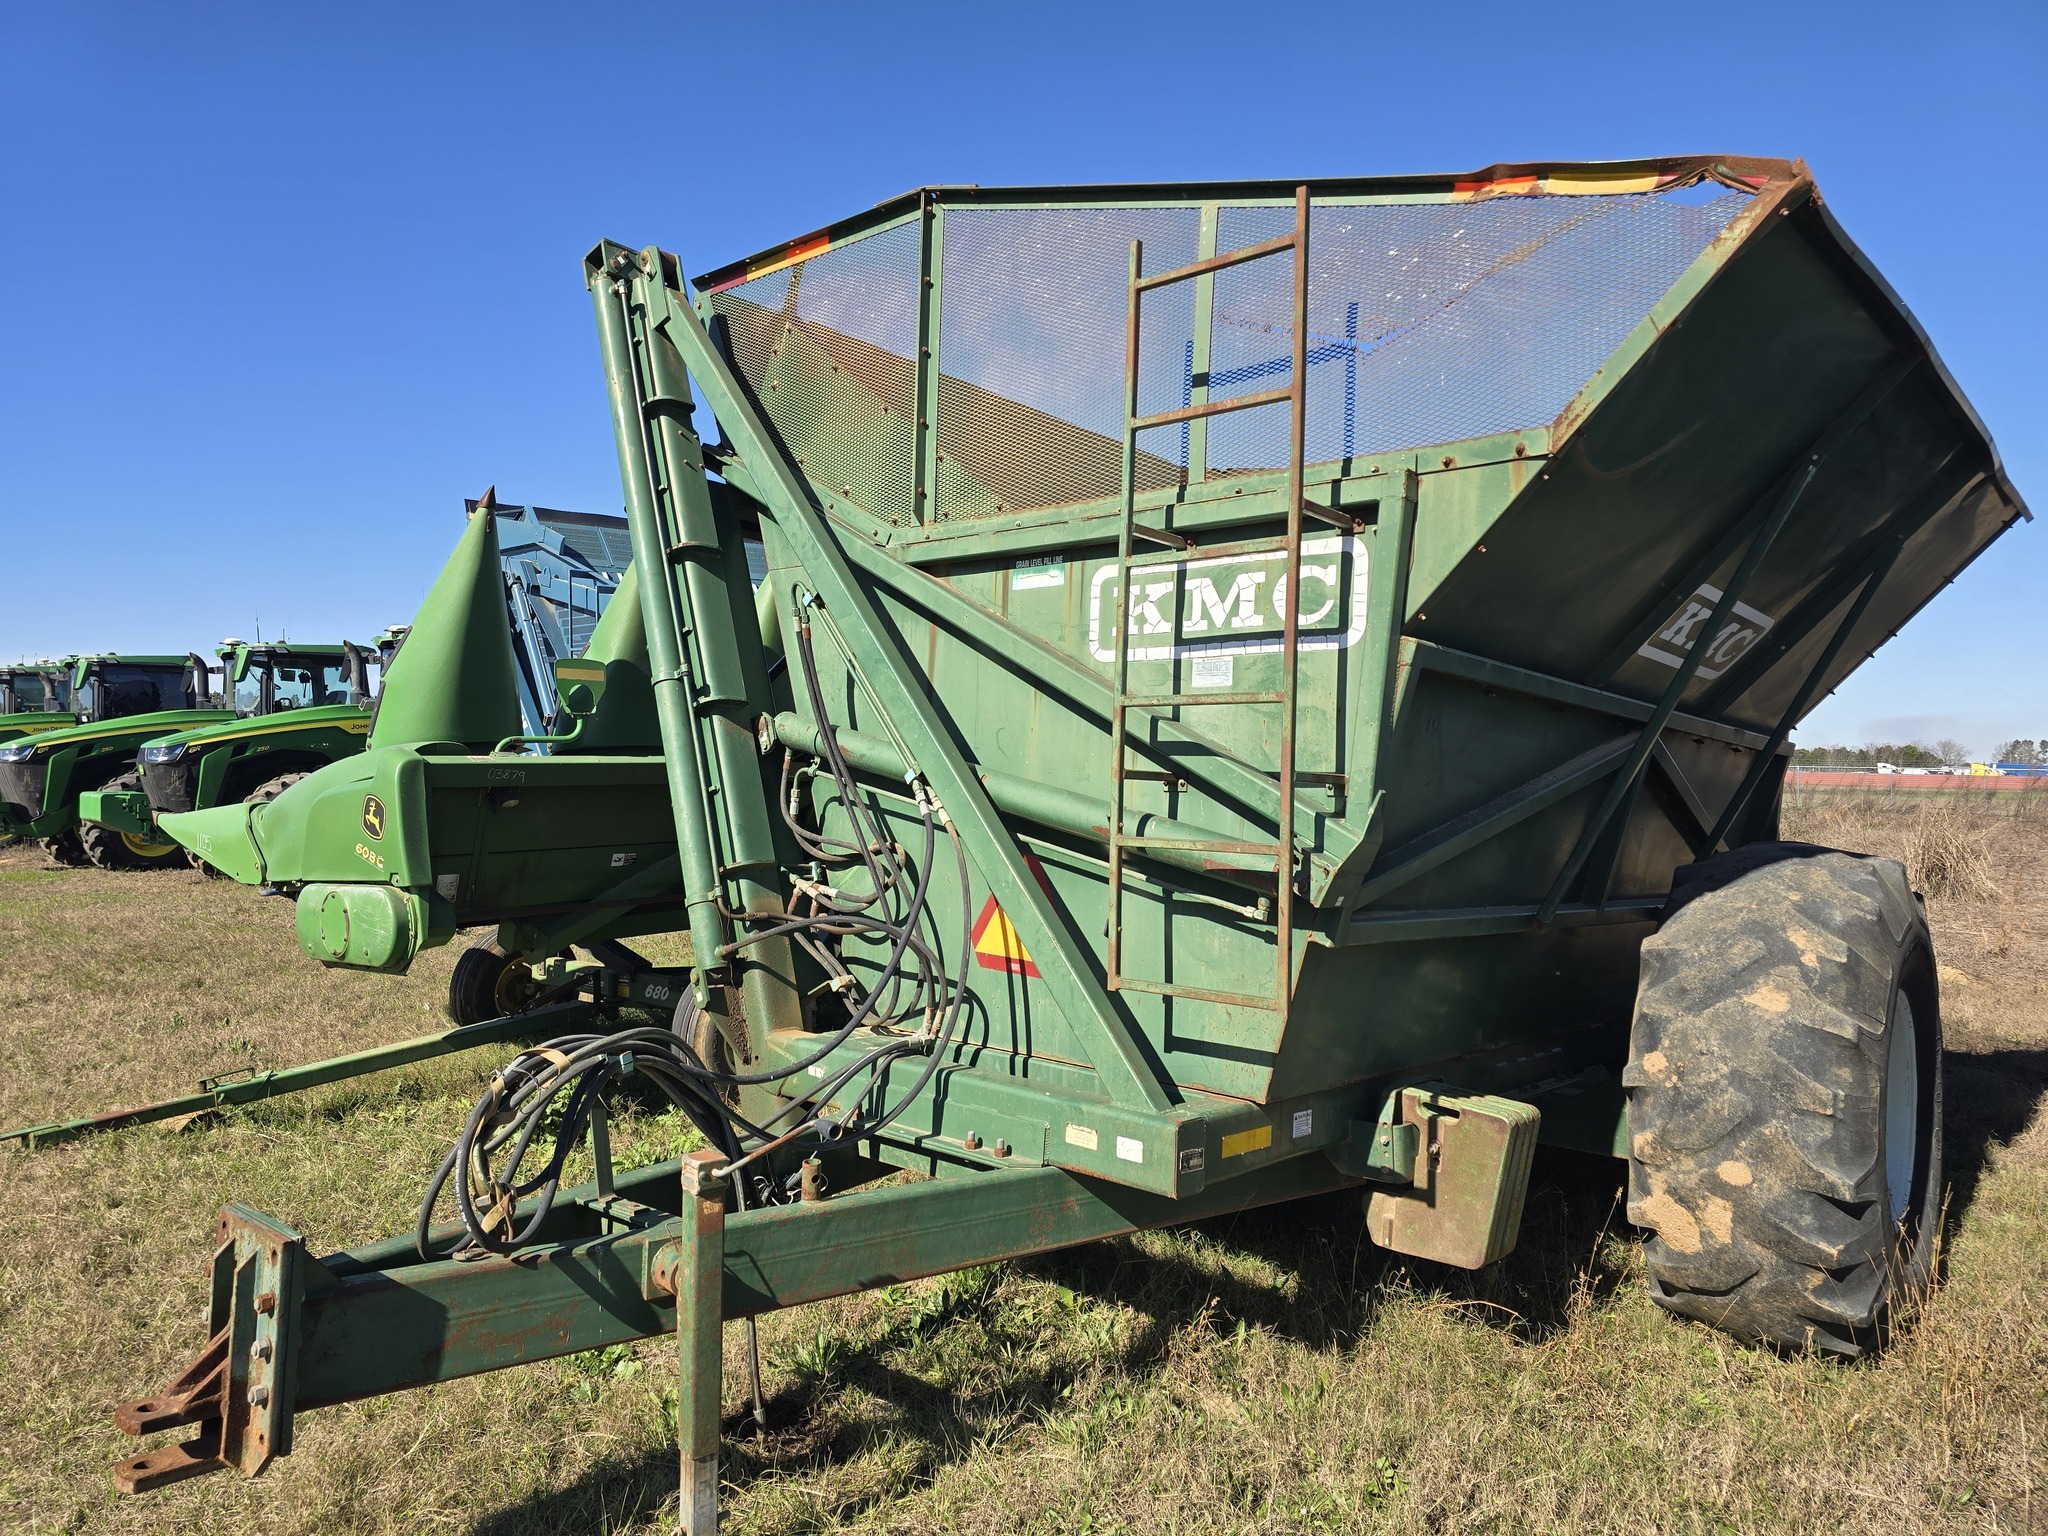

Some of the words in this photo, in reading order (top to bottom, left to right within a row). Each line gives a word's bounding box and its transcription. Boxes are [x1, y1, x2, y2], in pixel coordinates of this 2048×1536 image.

[1030, 558, 1043, 567] LEVEL
[1044, 556, 1052, 566] FILL
[1053, 555, 1063, 564] LINE
[1111, 564, 1337, 637] KMC
[487, 768, 526, 783] 03879
[645, 984, 670, 1000] 680
